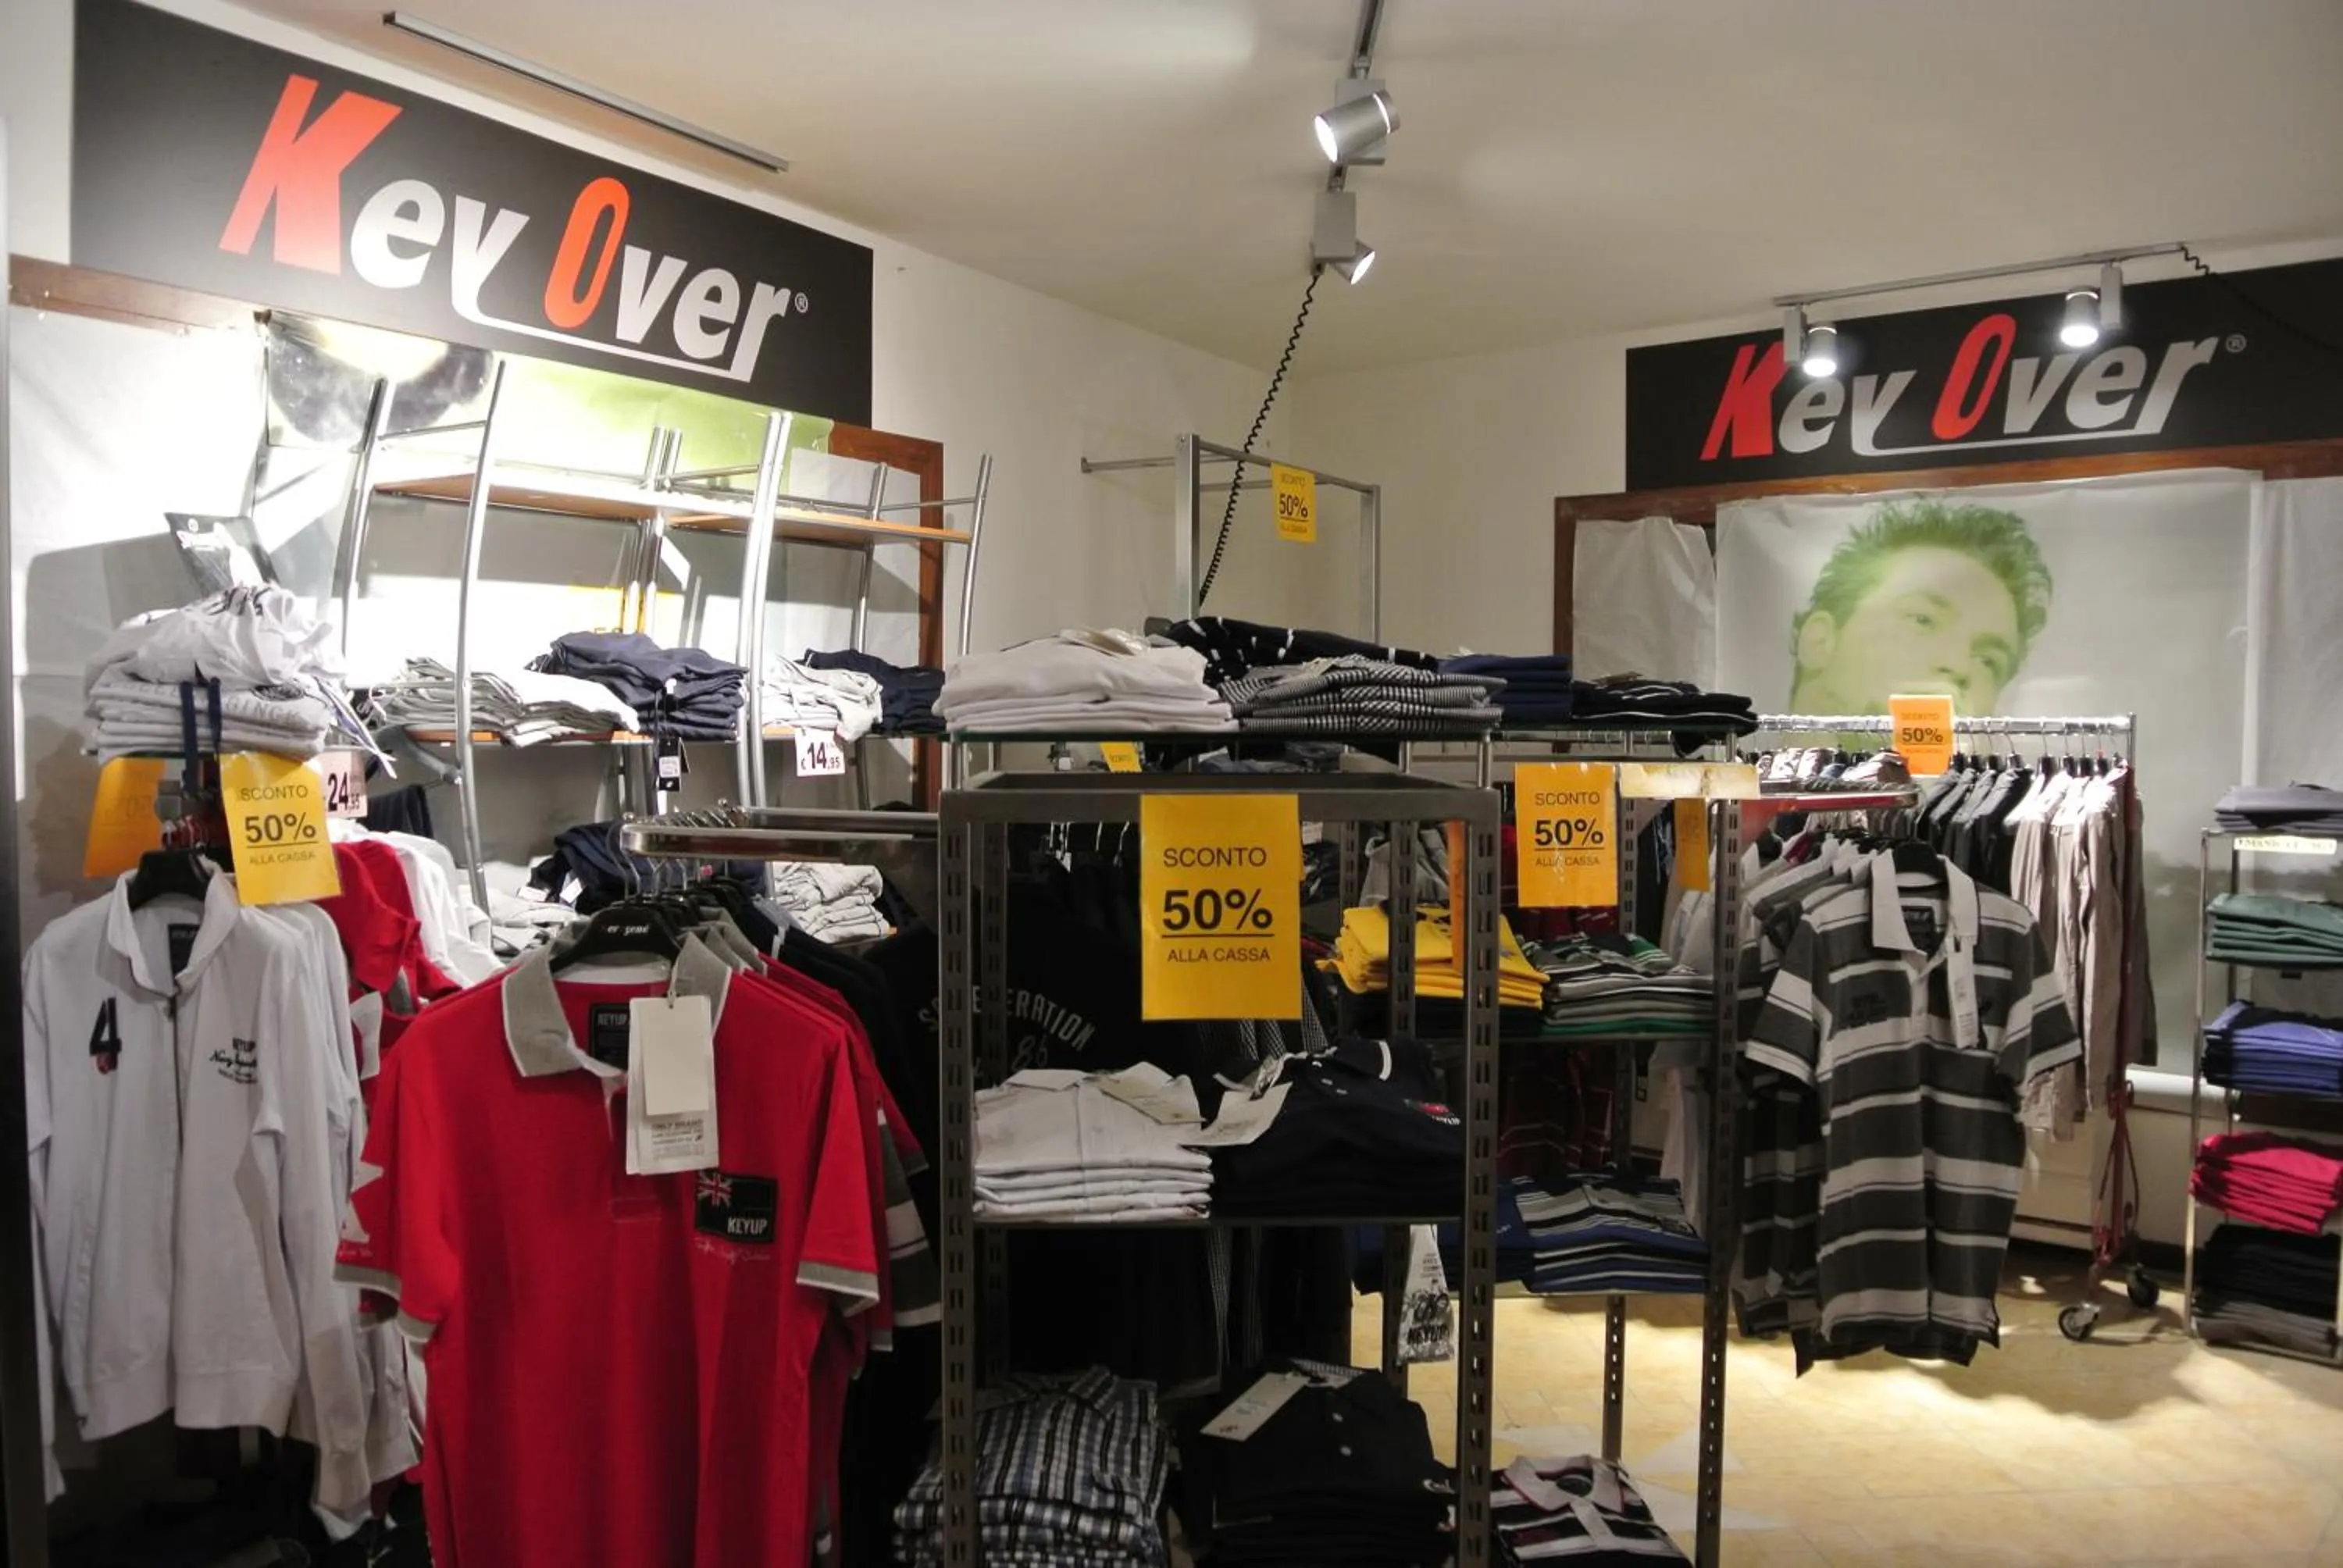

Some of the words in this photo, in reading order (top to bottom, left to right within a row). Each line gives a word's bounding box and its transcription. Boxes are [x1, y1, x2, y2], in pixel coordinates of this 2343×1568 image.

[219, 73, 530, 322] Key
[1700, 340, 1917, 461] Key
[1279, 493, 1308, 519] 50%
[1902, 727, 1944, 743] 50%
[240, 785, 308, 801] SCONTO
[1535, 791, 1601, 806] SCONTO
[244, 812, 316, 843] 50%
[1535, 818, 1603, 846] 50%
[249, 851, 275, 864] ALLA
[277, 849, 316, 862] CASSA
[1163, 847, 1267, 868] SCONTO
[1535, 857, 1560, 867] ALLA
[1564, 855, 1600, 866] CASSA
[1163, 888, 1273, 931] 50%
[1168, 947, 1208, 962] ALLA
[1213, 947, 1271, 962] CASSA
[727, 1217, 768, 1235] KEYUP
